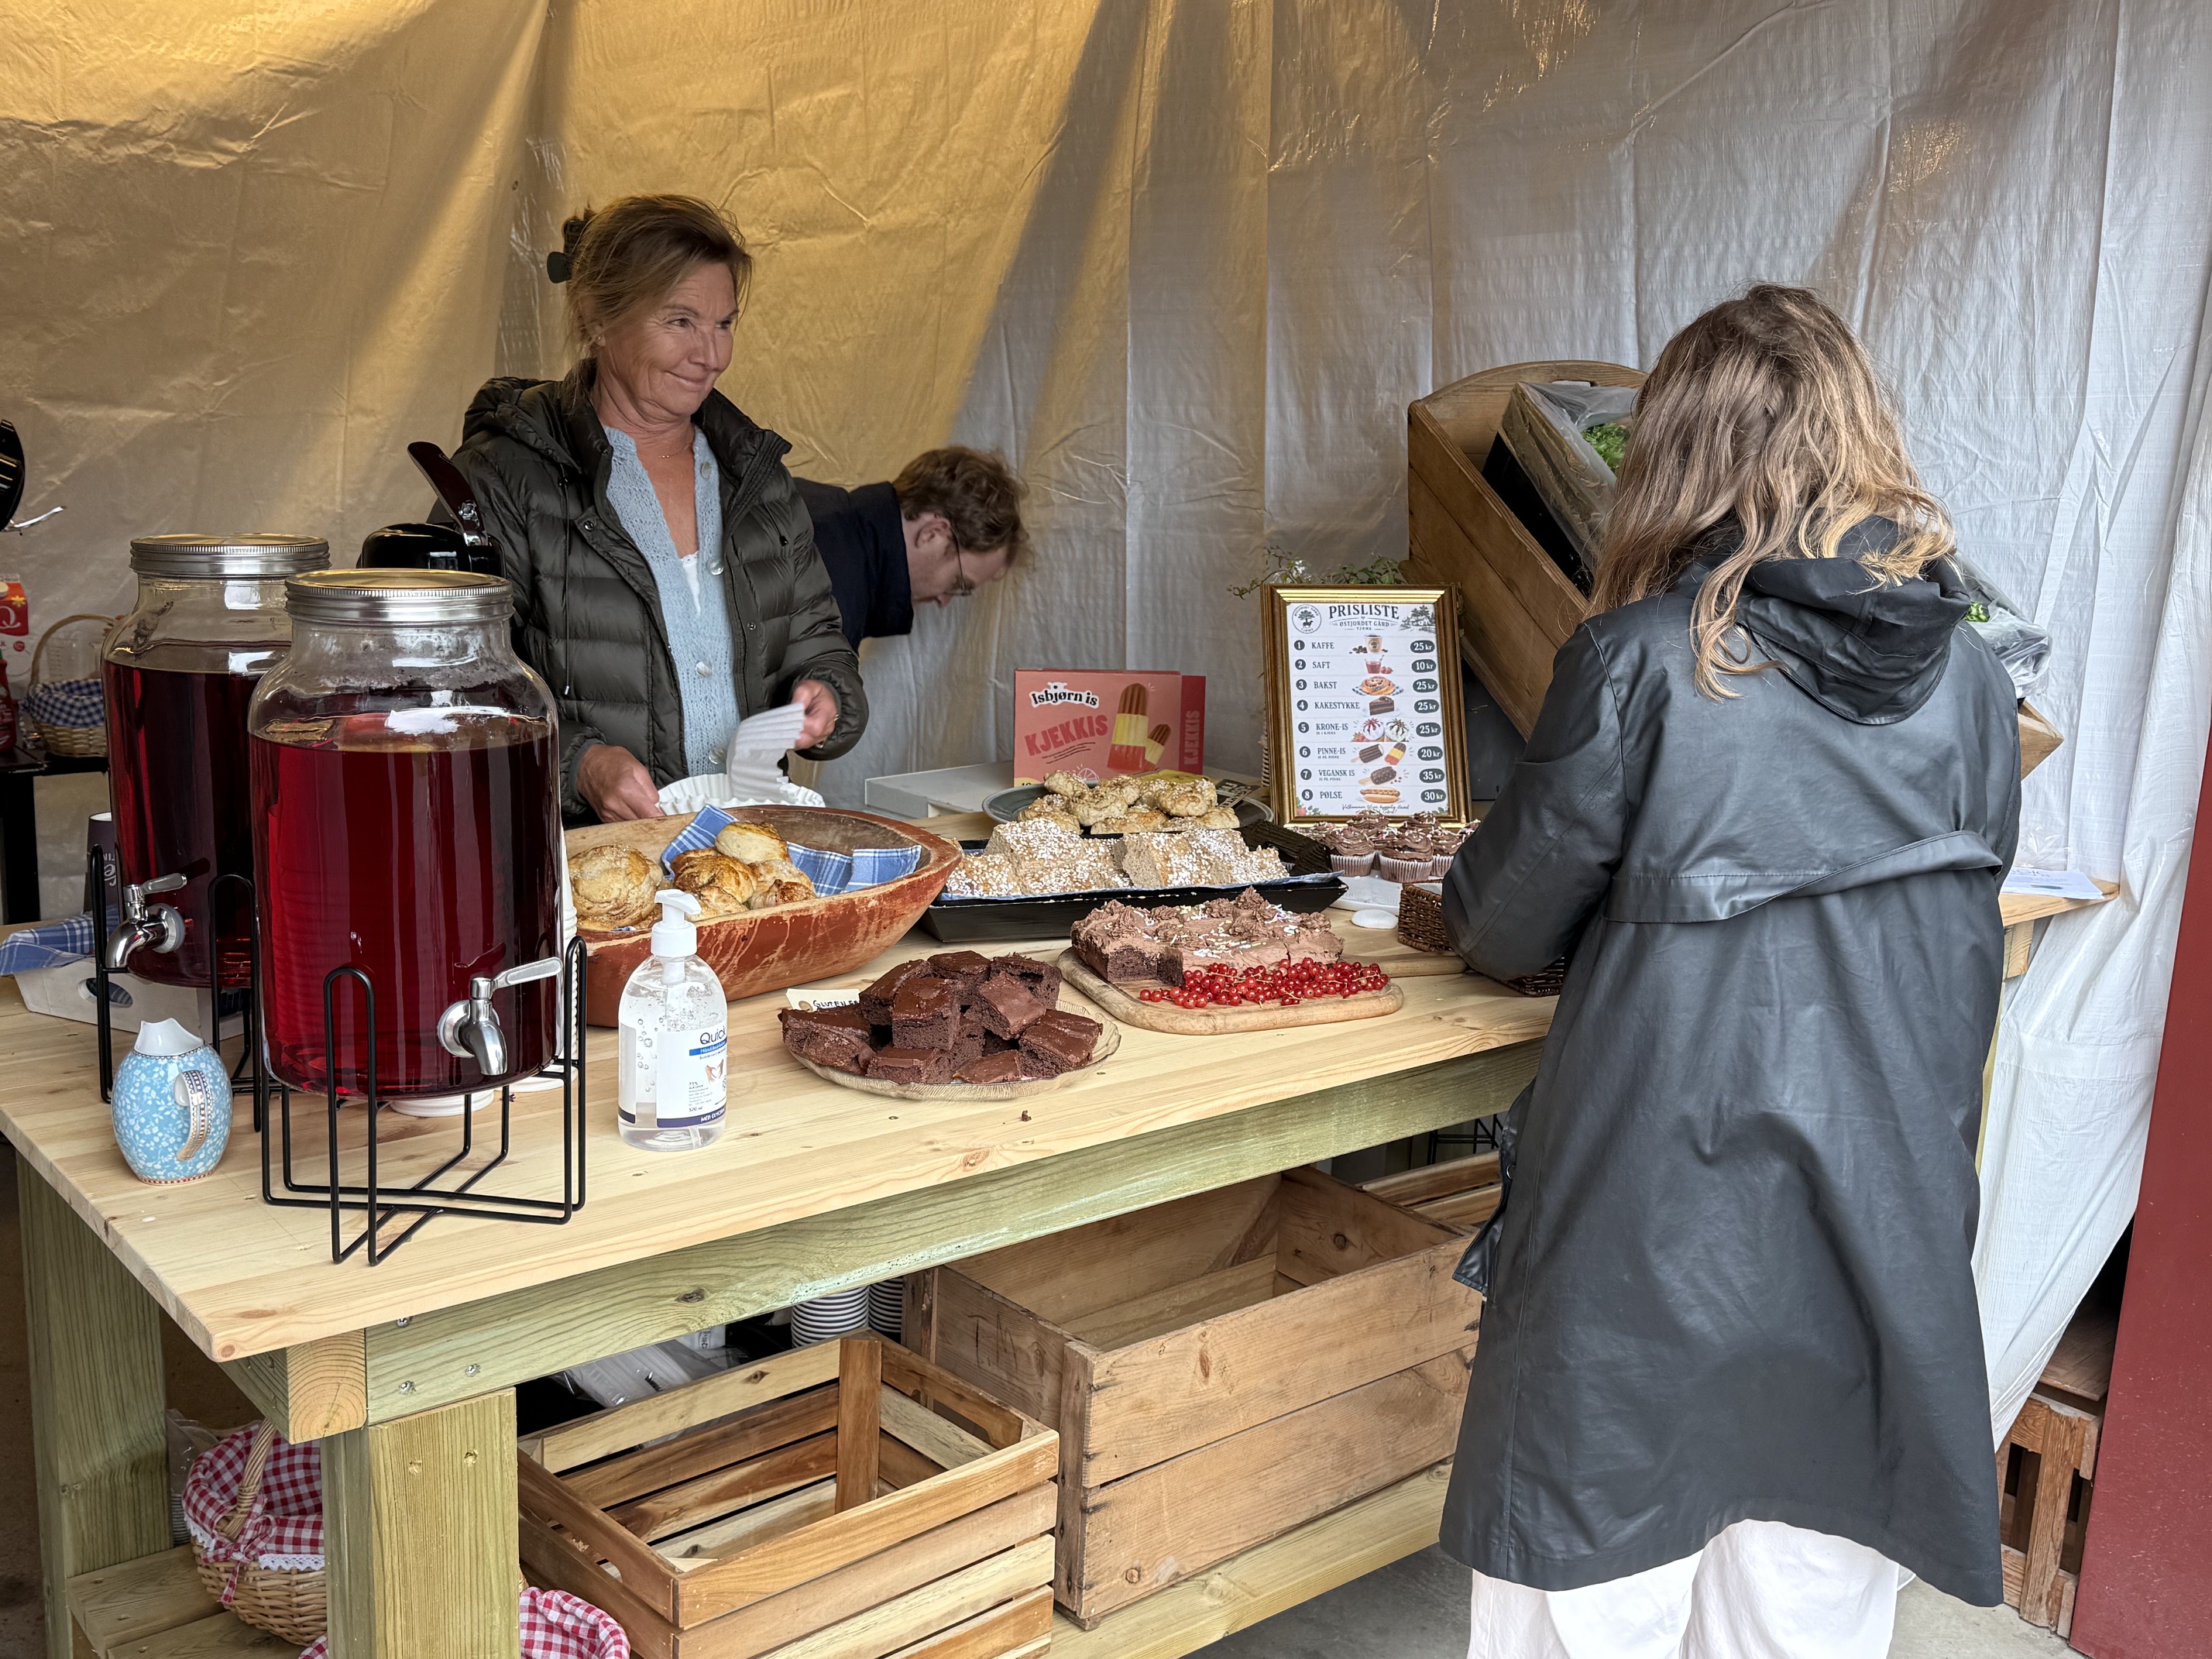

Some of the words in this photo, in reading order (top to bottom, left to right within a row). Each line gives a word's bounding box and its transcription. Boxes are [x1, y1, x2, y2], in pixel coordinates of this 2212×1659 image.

[1329, 604, 1400, 620] PRISLISTE
[1413, 642, 1424, 651] 25
[1416, 661, 1425, 670] 10
[1416, 681, 1427, 689] 25
[1032, 686, 1083, 704] Isbjørn
[1085, 692, 1097, 706] is
[1417, 702, 1428, 710] 25
[1420, 725, 1430, 734] 25
[1025, 715, 1108, 756] KJEKKIS
[1183, 710, 1200, 764] KJEKKIS
[1421, 749, 1432, 757] 20
[1423, 771, 1434, 780] 35
[1424, 792, 1435, 801] 30
